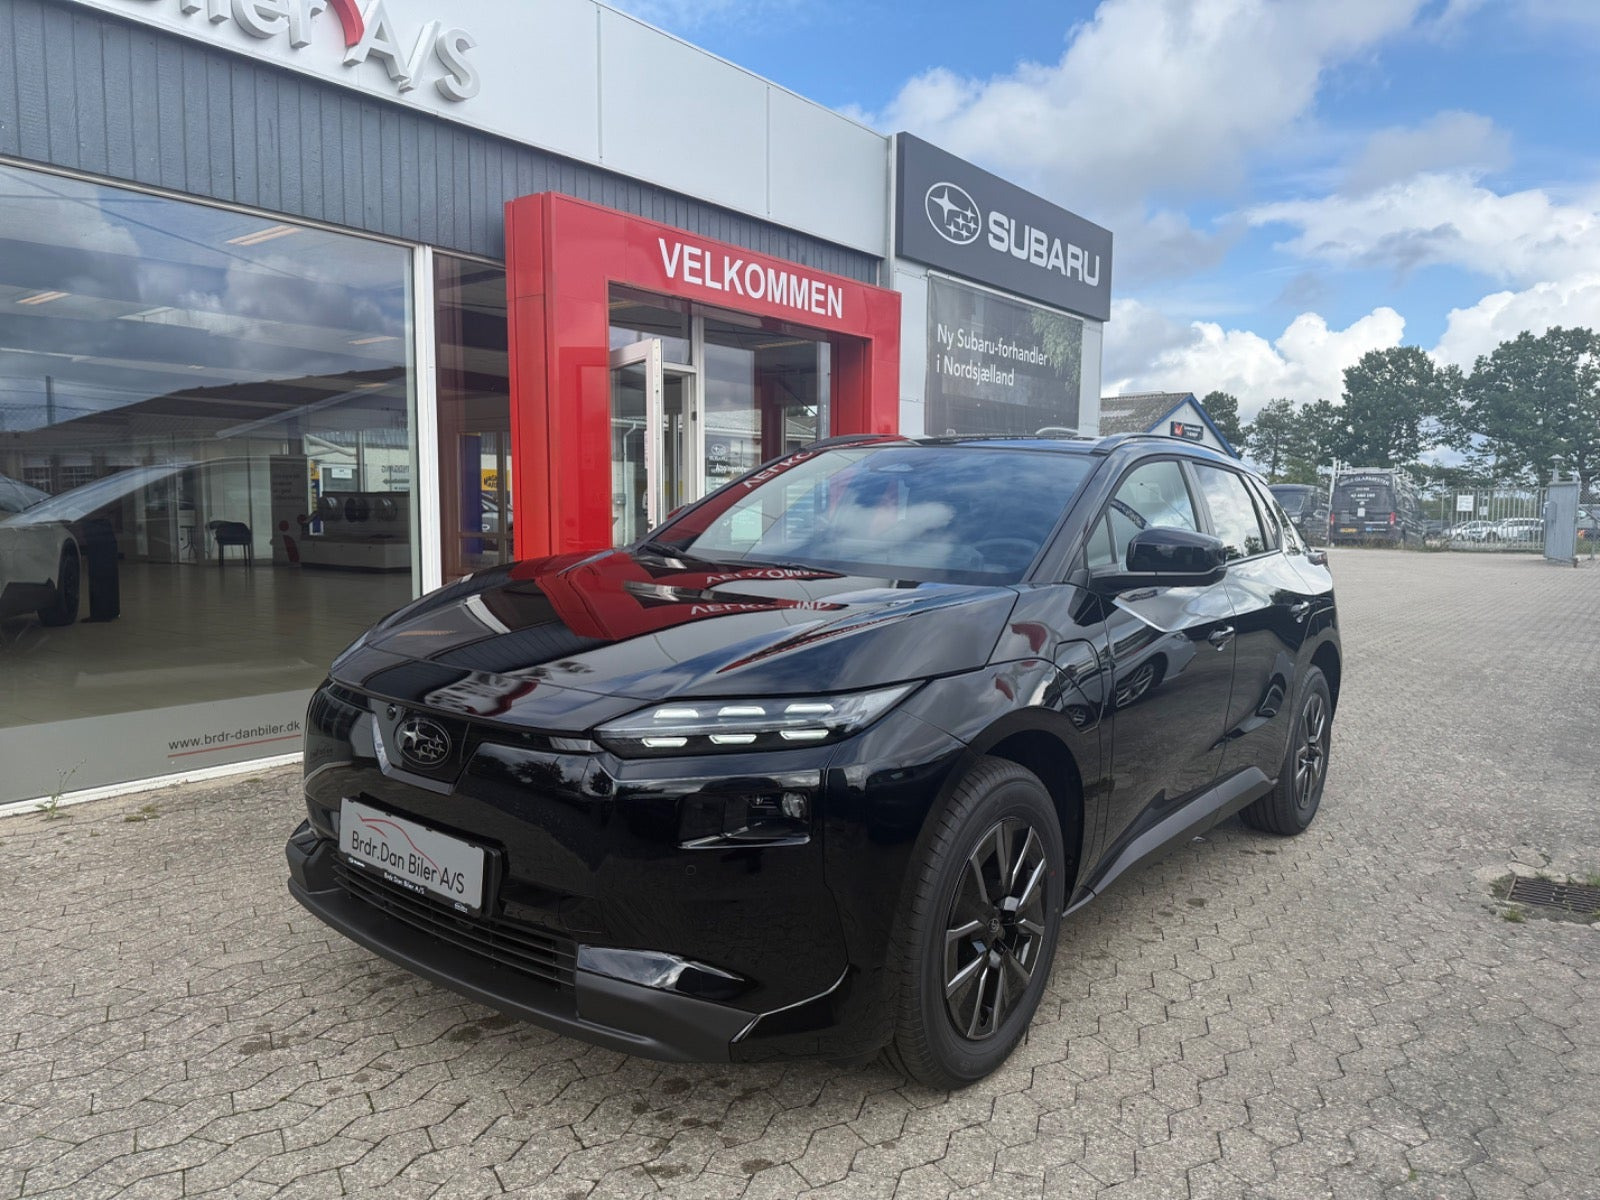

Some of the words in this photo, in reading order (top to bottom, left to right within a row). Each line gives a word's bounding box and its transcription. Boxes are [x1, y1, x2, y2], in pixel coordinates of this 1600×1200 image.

[343, 0, 482, 101] A/S
[987, 210, 1100, 287] SUBARU
[658, 237, 843, 319] VELKOMMEN
[937, 323, 954, 351] Ny
[957, 328, 1048, 366] Subaru-forhandler
[936, 354, 940, 373] i
[943, 356, 1015, 386] Nordsjælland
[168, 721, 301, 750] www.brdr-danbiler.dk
[408, 853, 437, 882] Biler
[440, 867, 465, 894] A/S
